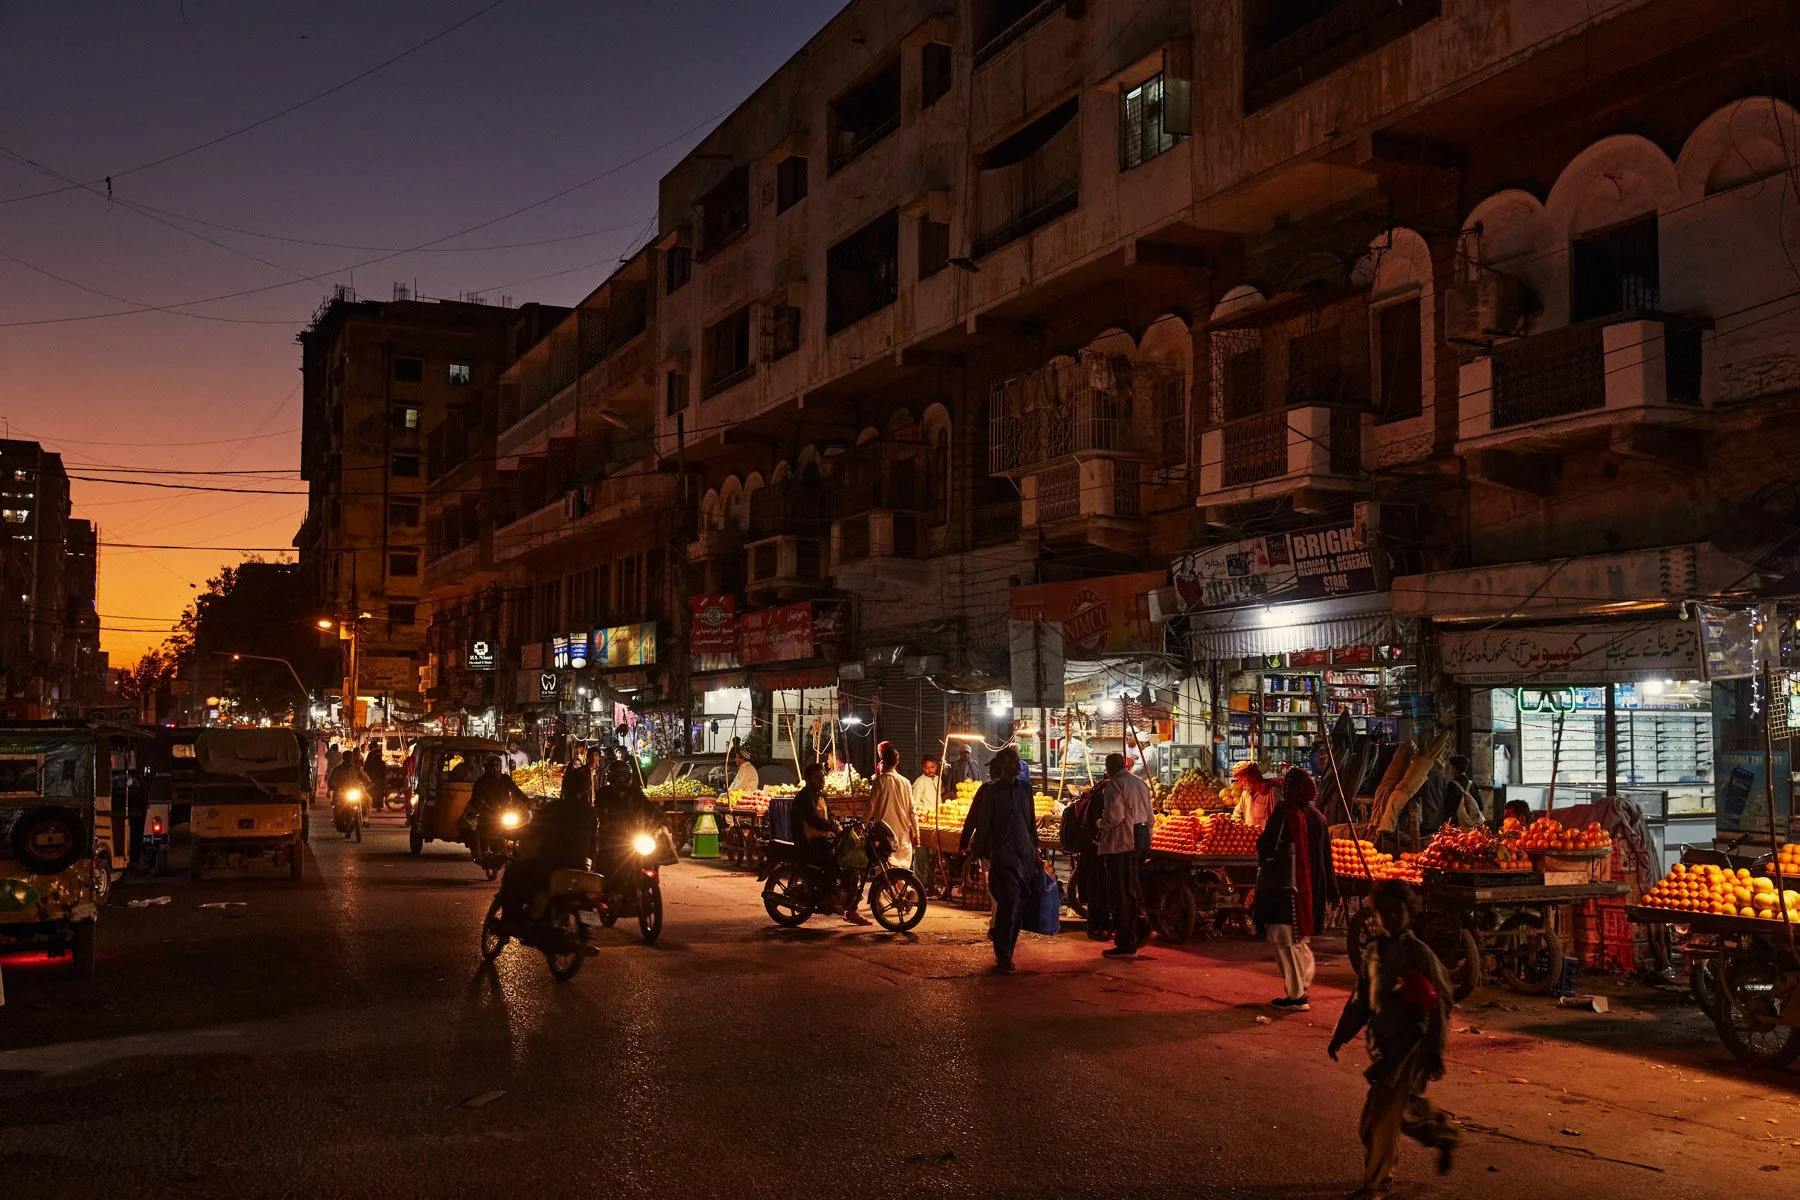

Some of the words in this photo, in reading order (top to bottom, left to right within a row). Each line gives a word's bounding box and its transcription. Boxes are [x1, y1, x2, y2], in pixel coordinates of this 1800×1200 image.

[1294, 527, 1359, 559] BRIGH
[1297, 557, 1329, 577] MEDICAL
[1330, 560, 1336, 574] &
[1337, 552, 1371, 573] GENERAL
[1323, 574, 1349, 593] STORE
[1065, 604, 1109, 640] NIMCO
[1483, 673, 1508, 682] PAKISTAN
